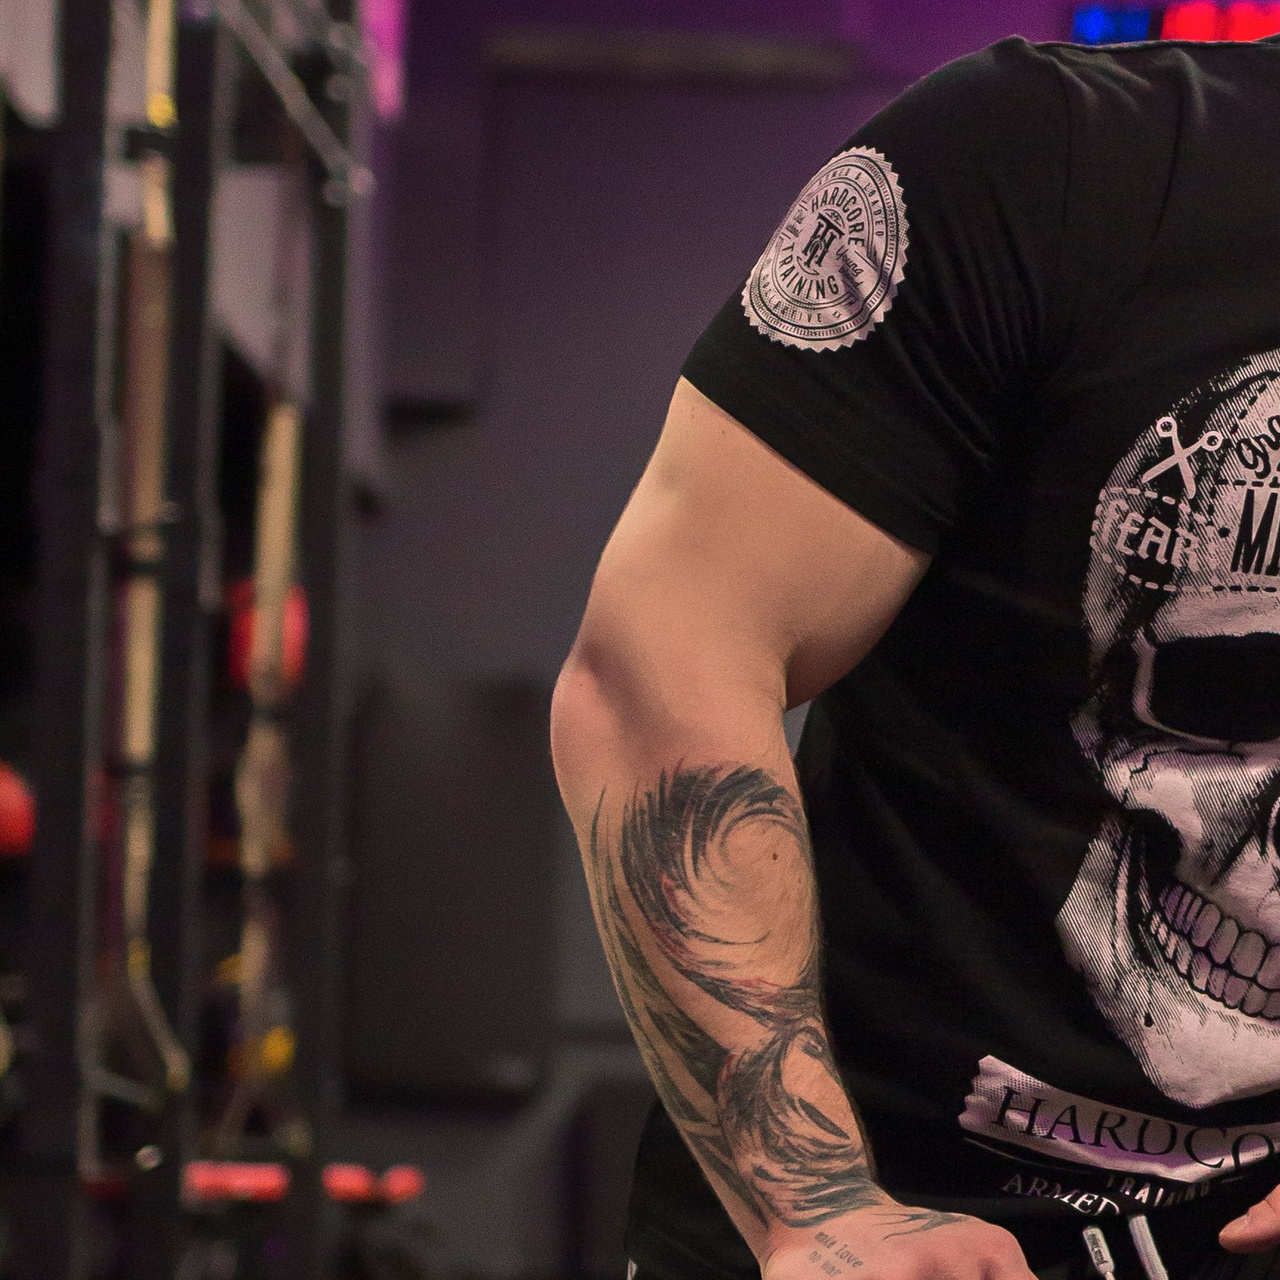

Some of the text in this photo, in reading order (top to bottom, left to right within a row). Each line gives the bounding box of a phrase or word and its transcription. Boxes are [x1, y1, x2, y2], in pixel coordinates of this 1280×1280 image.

[811, 186, 865, 248] HARDCORE
[779, 241, 840, 300] TRAINING
[1002, 1173, 1121, 1217] ARMED
